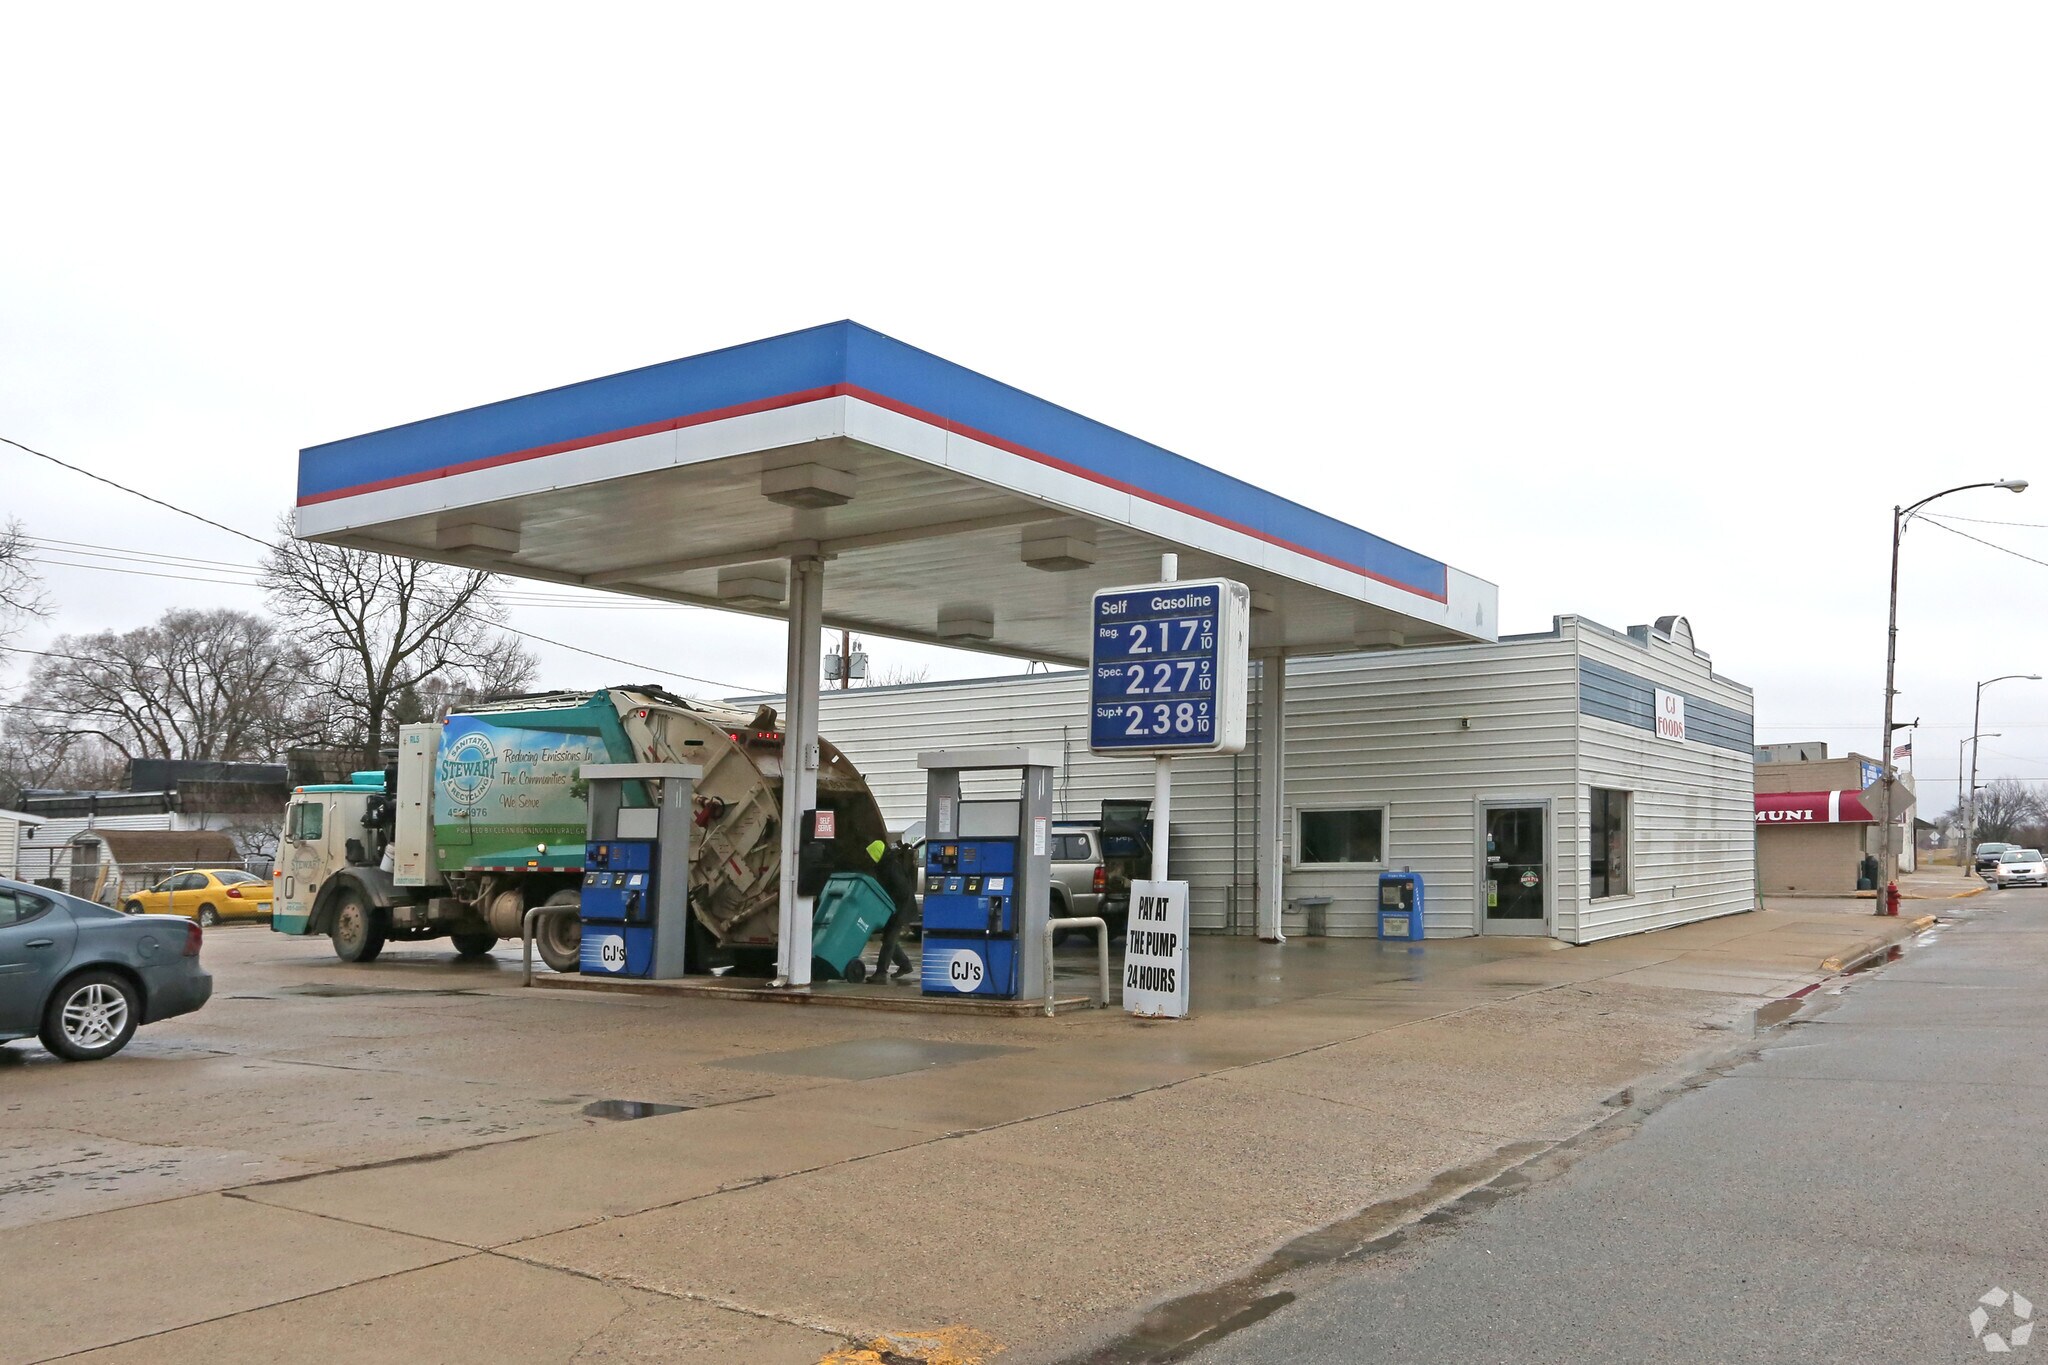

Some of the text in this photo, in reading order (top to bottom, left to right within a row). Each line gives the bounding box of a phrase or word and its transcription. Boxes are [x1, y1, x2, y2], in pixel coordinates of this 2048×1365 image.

[1101, 594, 1211, 615] Self Gasoline
[1100, 628, 1119, 639] Reg.
[1128, 620, 1198, 654] 2.17
[1098, 667, 1123, 678] Spec.
[1126, 661, 1195, 694] 2.27
[1665, 695, 1676, 715] CJ
[1125, 702, 1194, 735] 2.38
[1657, 716, 1684, 739] FOODS
[451, 737, 490, 757] SANITATION
[503, 747, 593, 766] Reducing Emissions In
[441, 756, 498, 782] STEWART
[501, 770, 566, 786] The Communities
[451, 778, 489, 801] RECYCLING
[499, 793, 540, 808] We Serve
[447, 807, 488, 817] 450976
[820, 816, 831, 825] SELF
[544, 827, 574, 835] NATURAL
[575, 827, 587, 835] GA
[817, 824, 832, 832] SERVE
[1138, 896, 1169, 921] PAY AT
[603, 945, 625, 961] CJ's
[1130, 930, 1177, 957] THE PUMP
[951, 961, 981, 980] CJ's
[1127, 964, 1175, 993] 24 HOURS
